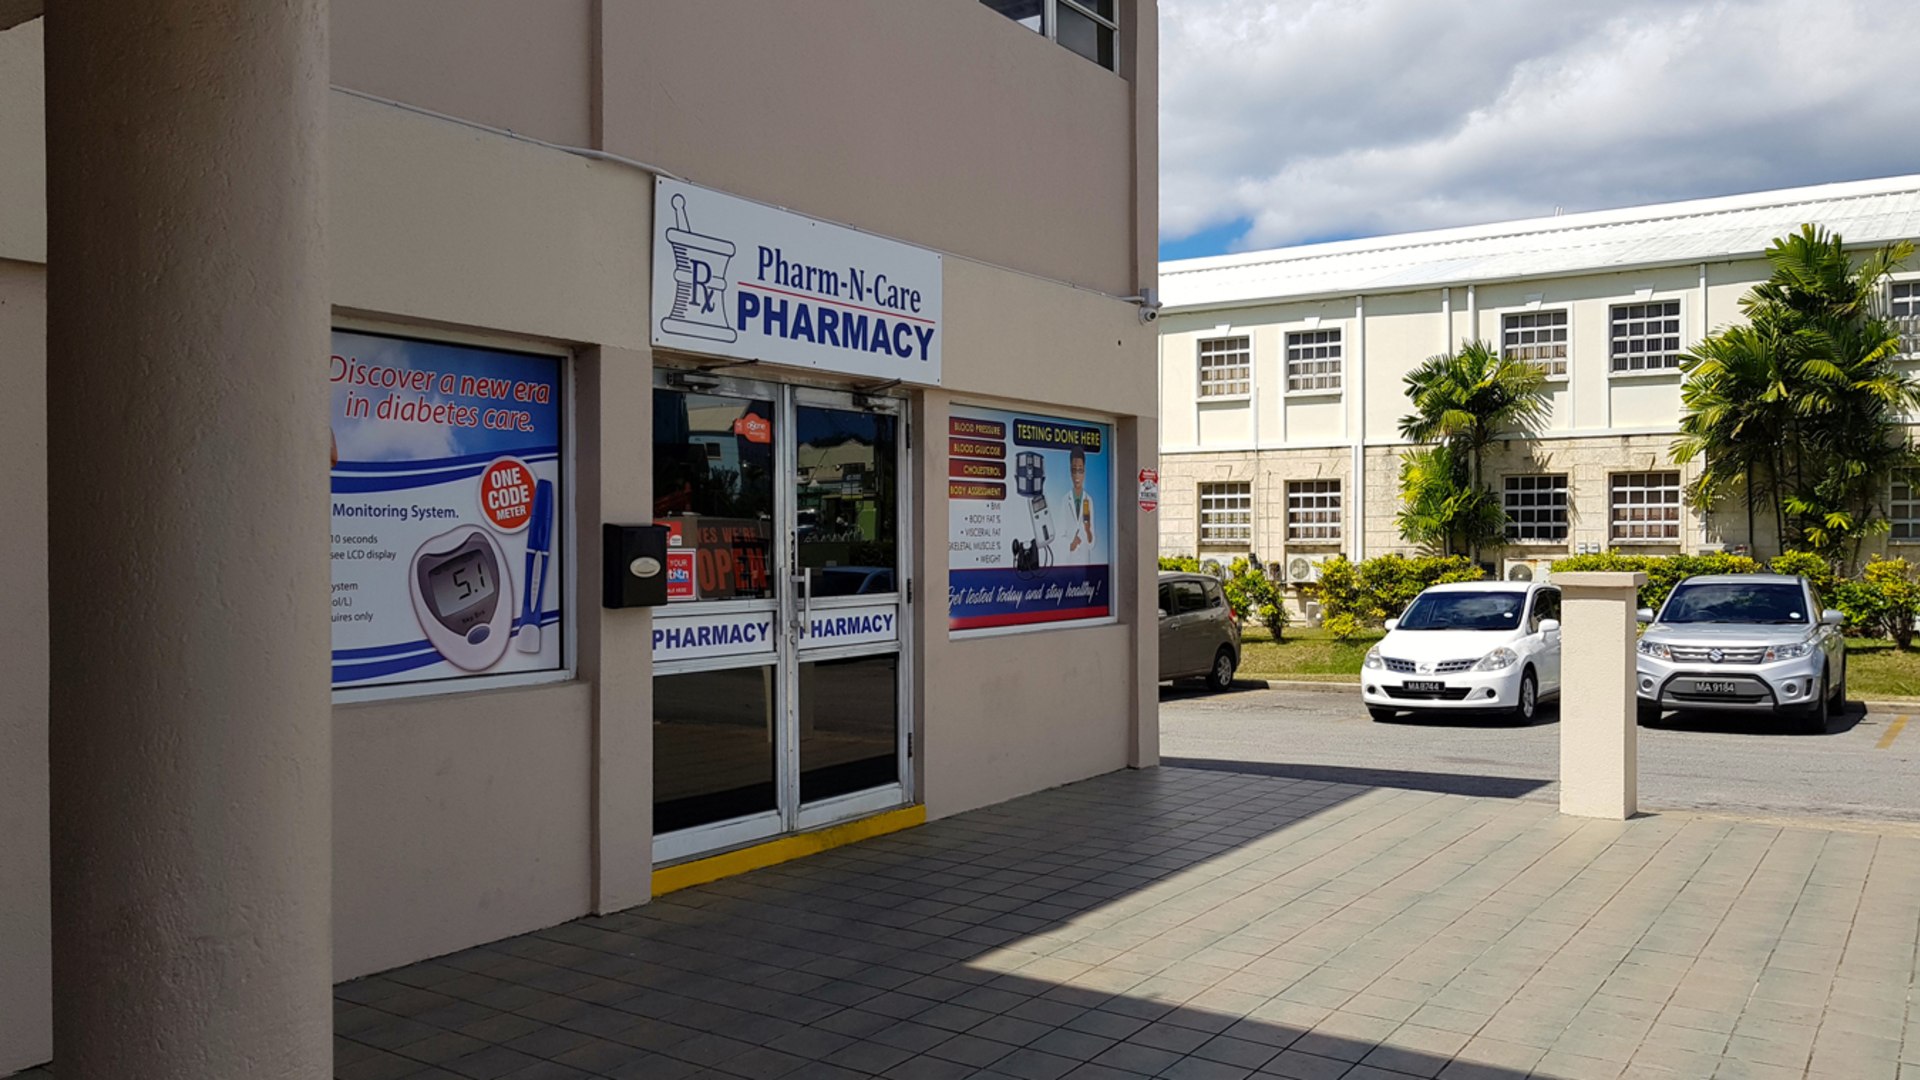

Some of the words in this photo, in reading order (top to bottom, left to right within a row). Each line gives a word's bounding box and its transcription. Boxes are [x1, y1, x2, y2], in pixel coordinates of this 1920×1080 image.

[757, 245, 922, 313] Pharm-N-Care
[737, 291, 935, 361] PHARMACY
[329, 355, 435, 391] Discover
[440, 374, 455, 394] a
[460, 376, 510, 399] new
[514, 381, 550, 404] era
[345, 391, 370, 418] in
[376, 393, 478, 426] diabetes
[483, 409, 534, 431] care.
[954, 421, 975, 432] BLOOD
[976, 424, 1001, 436] PRESSURE
[1017, 424, 1053, 442] TESTING
[1055, 428, 1080, 444] DONE
[1081, 431, 1100, 446] HERE
[954, 443, 974, 454] BLOOD
[491, 467, 521, 489] ONE
[488, 484, 530, 509] CODE
[950, 485, 967, 495] BODY
[332, 503, 408, 521] Monitoring
[411, 505, 459, 521] System.
[496, 505, 526, 520] METER
[342, 534, 378, 544] seconds
[697, 527, 718, 544] YES
[347, 549, 365, 560] LCD
[366, 549, 396, 561] display
[670, 559, 688, 567] YOUR
[697, 548, 767, 592] OPEN
[331, 583, 359, 593] ystem
[453, 562, 486, 600] 5.1
[332, 597, 352, 607] ol/L)
[966, 584, 996, 605] tested
[996, 584, 1022, 609] today
[1025, 583, 1045, 600] and
[1045, 581, 1063, 606] stay
[331, 612, 352, 622] uires
[353, 611, 374, 623] only
[652, 622, 770, 650] PHARMACY
